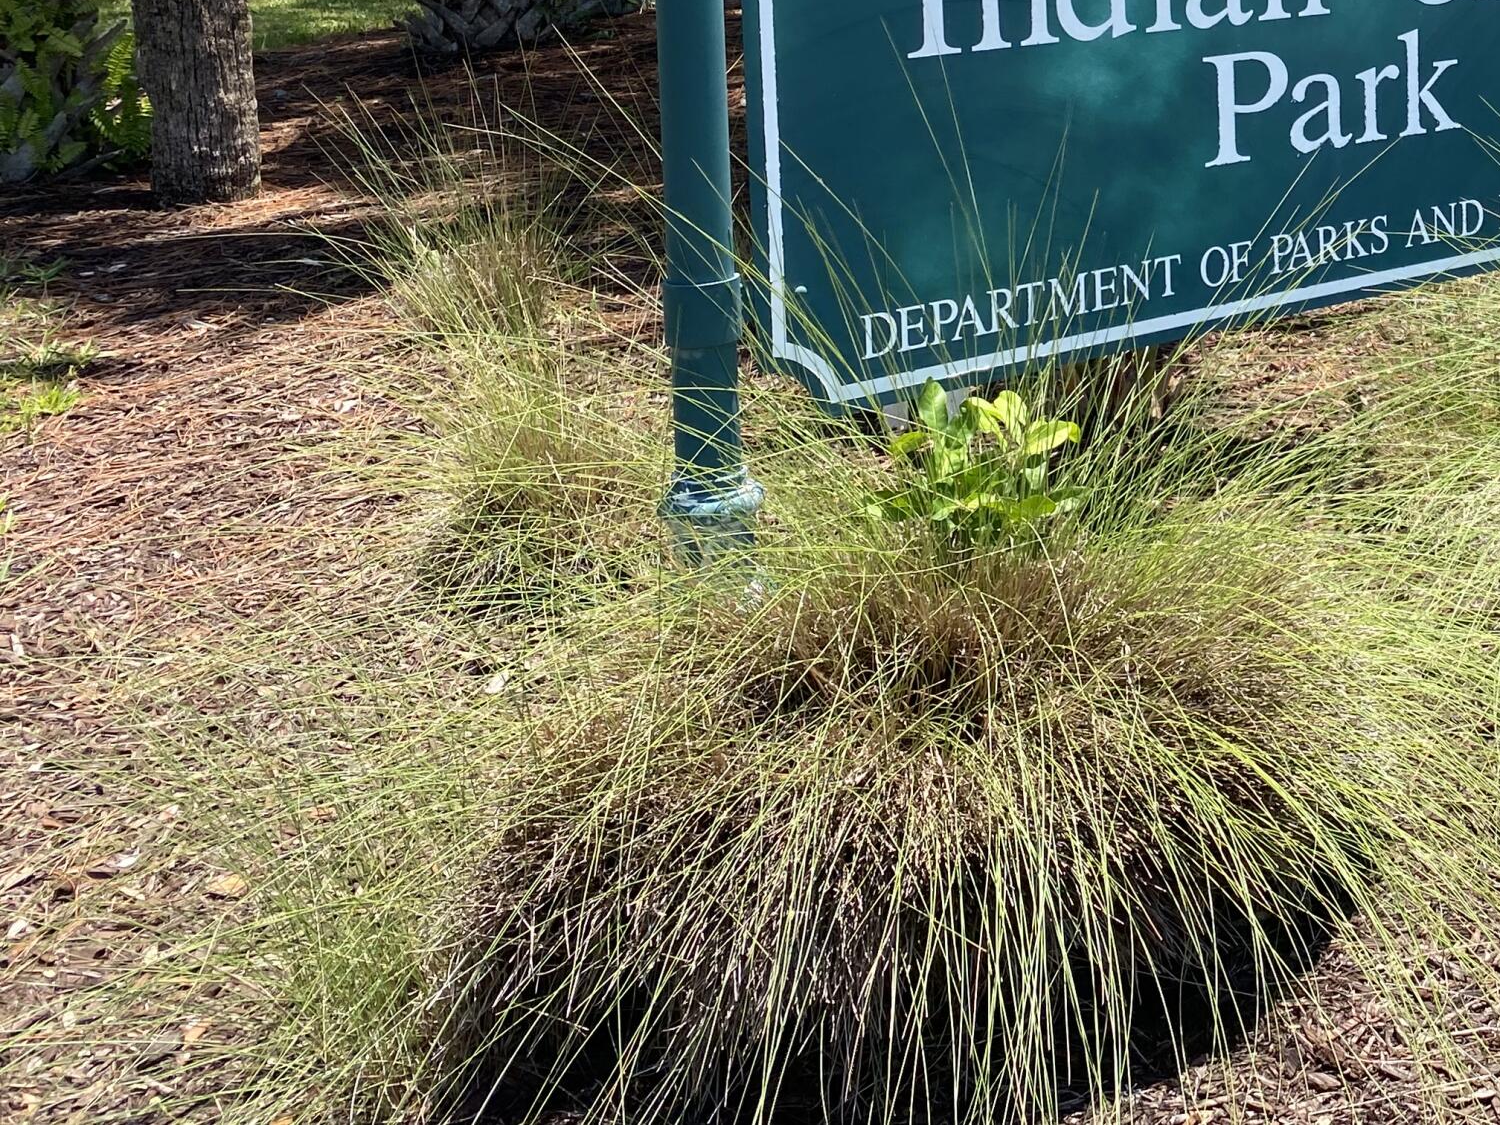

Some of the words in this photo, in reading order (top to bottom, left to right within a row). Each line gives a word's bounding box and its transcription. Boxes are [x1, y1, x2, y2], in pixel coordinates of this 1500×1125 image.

[1202, 28, 1462, 169] Park
[860, 253, 1182, 360] DEPARTMENT
[1200, 240, 1252, 288] OF
[1270, 214, 1390, 276] PARKS
[1405, 198, 1485, 248] AND
